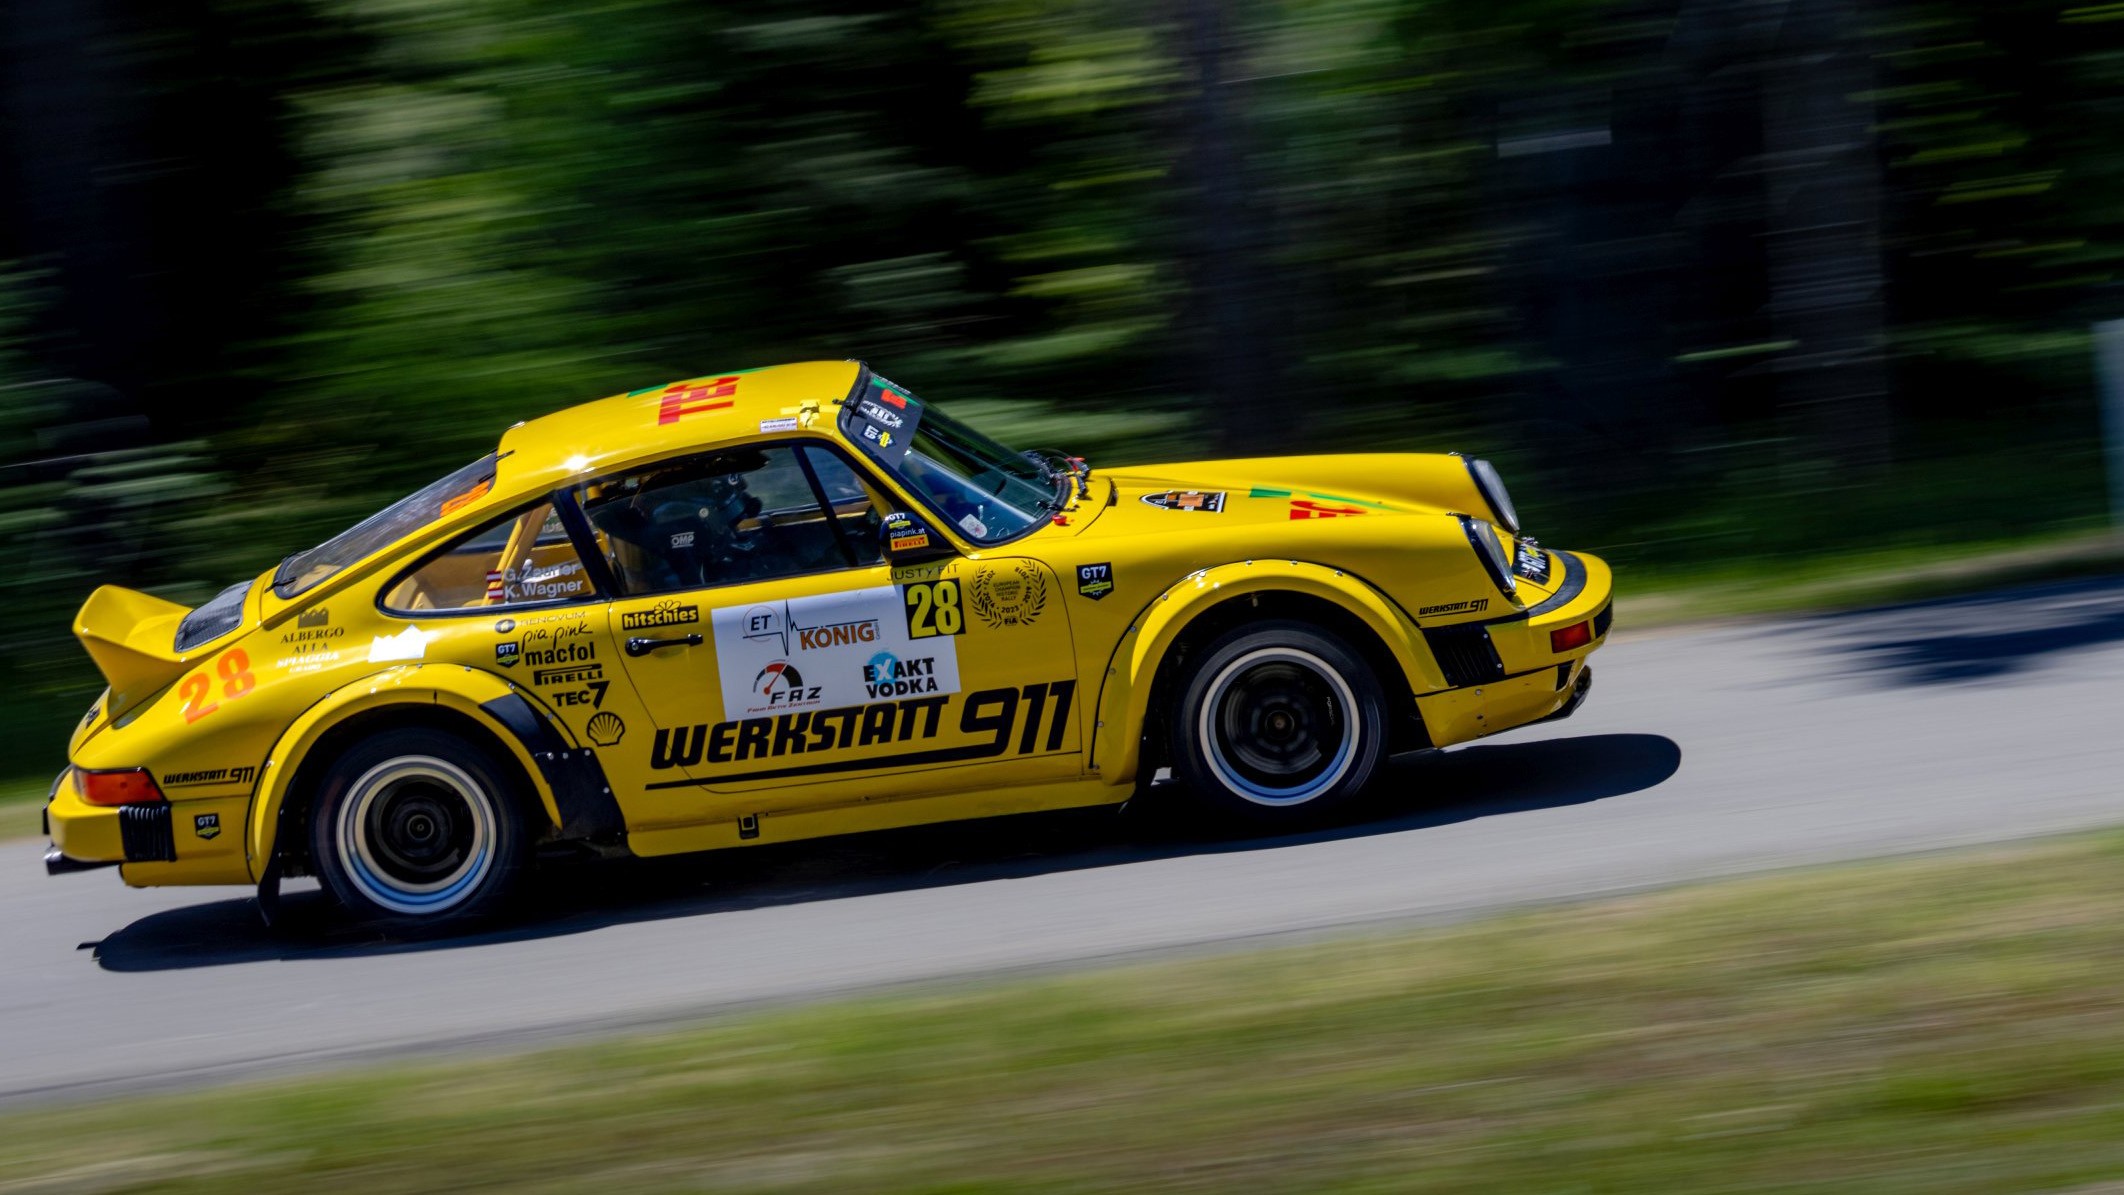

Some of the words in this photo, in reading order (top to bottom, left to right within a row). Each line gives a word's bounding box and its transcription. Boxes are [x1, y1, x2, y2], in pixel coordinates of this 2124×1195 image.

[671, 534, 695, 546] OMP
[890, 527, 925, 539] piapink.at
[894, 537, 925, 549] PIRELLI
[1081, 566, 1107, 580] GT7
[505, 585, 521, 598] K.
[522, 580, 583, 597] Wagner
[906, 579, 962, 638] 28
[1419, 602, 1468, 615] WERKSTATT
[1470, 599, 1488, 612] 911
[624, 610, 698, 628] hitschies
[750, 614, 772, 631] ET
[1004, 617, 1018, 625] FIA
[281, 627, 344, 643] ALBERGO
[800, 618, 875, 650] KÖNIG
[292, 643, 328, 654] ALLA
[497, 644, 516, 655] GT7
[525, 641, 595, 666] macfol
[533, 664, 603, 686] PIRELLI
[863, 657, 935, 683] EXAKT
[179, 647, 256, 725] 28
[866, 677, 938, 699] VODKA
[770, 686, 822, 705] FAZ
[651, 695, 949, 769] WERKSTATT
[959, 679, 1077, 757] 911
[163, 769, 226, 785] WERKSTATT
[229, 766, 255, 783] 911
[197, 816, 216, 826] GT7
